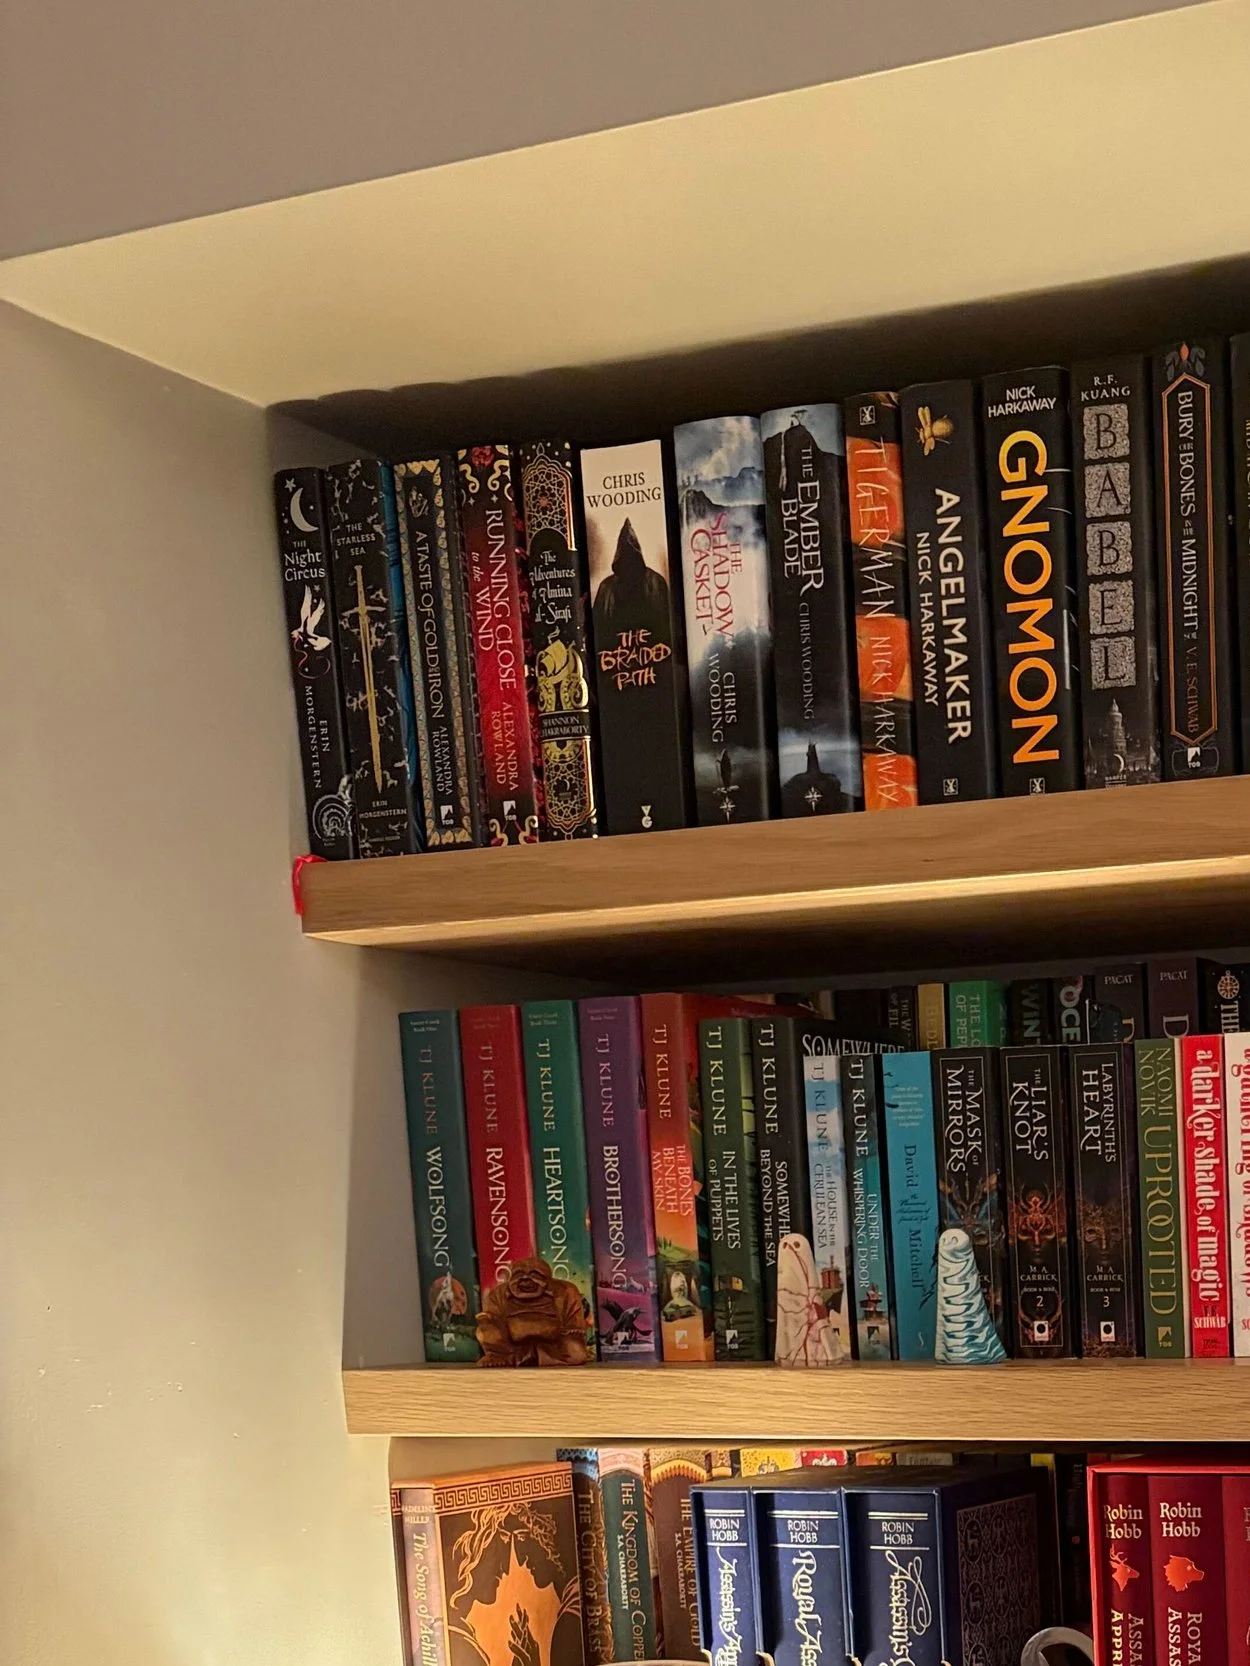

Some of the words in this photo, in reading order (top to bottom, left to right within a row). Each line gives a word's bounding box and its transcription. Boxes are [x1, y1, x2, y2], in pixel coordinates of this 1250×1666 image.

[1006, 386, 1036, 399] NICK
[1080, 386, 1130, 401] KUANG
[987, 398, 1056, 417] HARKAWAY
[602, 472, 645, 488] CHRIS
[587, 489, 662, 508] WOODING
[335, 533, 376, 546] STARLESS
[345, 523, 362, 532] THE
[855, 438, 895, 618] TIGERMAN
[284, 552, 322, 566] Night
[349, 547, 366, 556] SEA
[485, 509, 511, 621] RUNNING
[916, 532, 931, 585] NICK
[285, 566, 326, 581] Circus
[999, 431, 1059, 764] GNOMON
[935, 488, 972, 744] ANGELMAKER
[618, 629, 651, 645] THE
[920, 592, 939, 706] HARKAWAY
[494, 621, 516, 690] CLOSE
[599, 644, 671, 671] BRAIDED
[614, 669, 656, 691] PATH
[304, 685, 322, 789] MORGENSTERN
[319, 720, 330, 753] ERIN
[707, 1027, 722, 1048] TJ
[1195, 1050, 1212, 1061] a
[710, 1058, 727, 1136] KLUNE
[1186, 1065, 1222, 1141] darker
[946, 1065, 966, 1173] MIRRORS
[967, 1088, 983, 1153] MASK
[1012, 1082, 1032, 1155] KNOT
[1032, 1086, 1048, 1161] LIAR'S
[708, 1159, 718, 1175] OF
[723, 1151, 736, 1169] IN
[725, 1173, 738, 1205] THE
[1193, 1142, 1217, 1217] shade
[425, 1147, 450, 1268] WOLFSONG
[486, 1147, 512, 1284] RAVENSONG
[543, 1147, 570, 1283] HEARTSONG
[603, 1146, 630, 1289] BROTHERSONG
[709, 1178, 724, 1242] PUPPETS
[725, 1209, 741, 1250] LIVES
[1197, 1216, 1214, 1232] of
[1020, 1274, 1058, 1282] CARRICK
[1191, 1232, 1221, 1302] magic
[1036, 1296, 1044, 1306] 2
[1104, 1296, 1110, 1308] 3
[1159, 1502, 1202, 1519] Robin
[788, 1520, 819, 1532] ROBIN
[790, 1531, 818, 1543] HOBB
[1161, 1521, 1201, 1538] Hobb
[413, 1533, 426, 1560] The
[414, 1563, 429, 1600] Song
[791, 1549, 822, 1627] Royal
